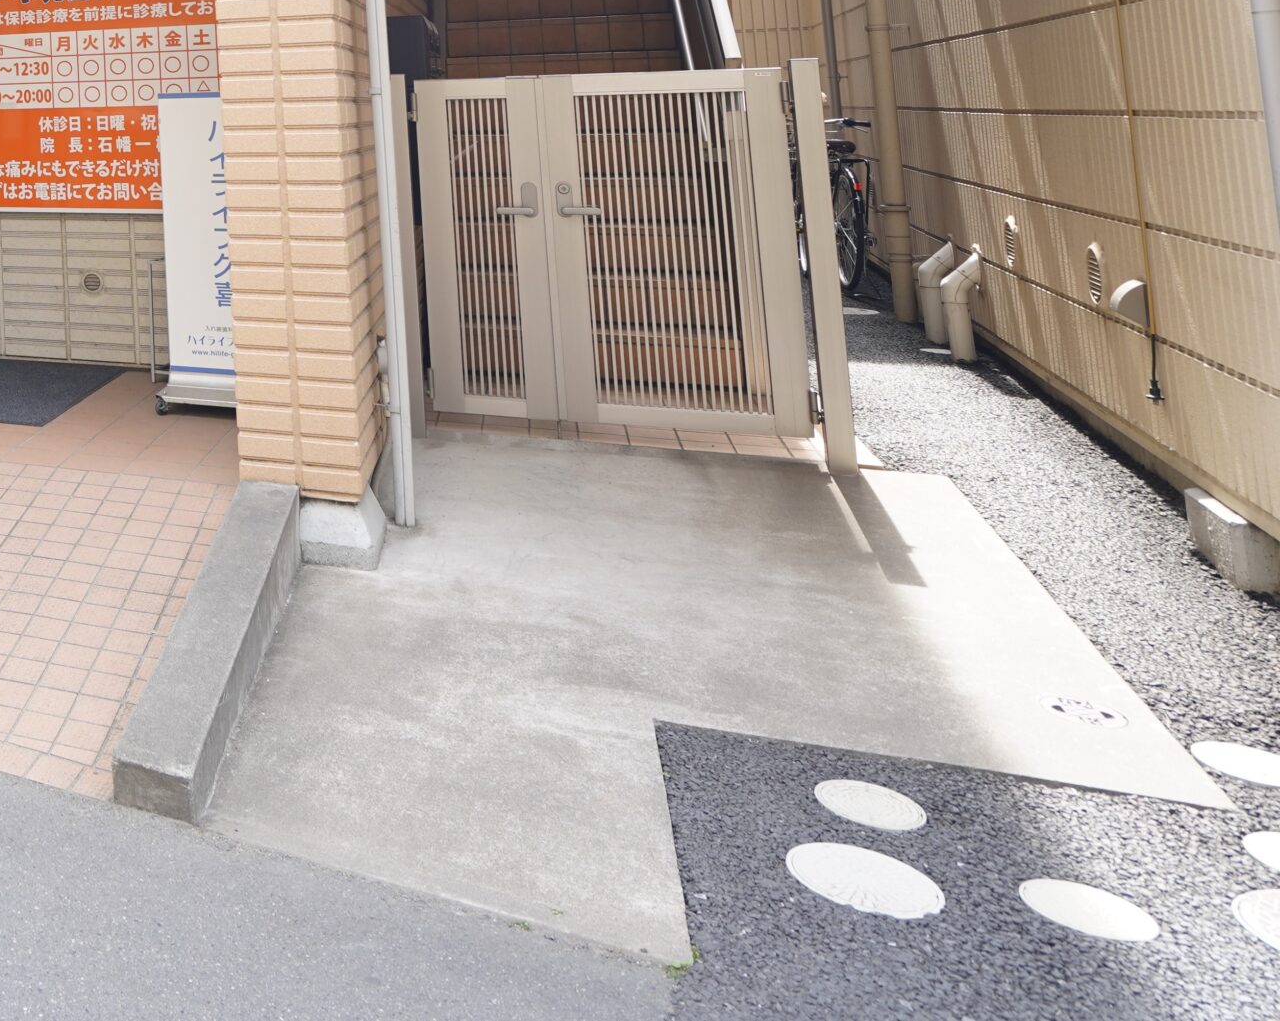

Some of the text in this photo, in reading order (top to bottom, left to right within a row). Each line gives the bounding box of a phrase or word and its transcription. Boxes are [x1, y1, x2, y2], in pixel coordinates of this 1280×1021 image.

[24, 29, 211, 52] 曜日 月 火 水 木 金 土
